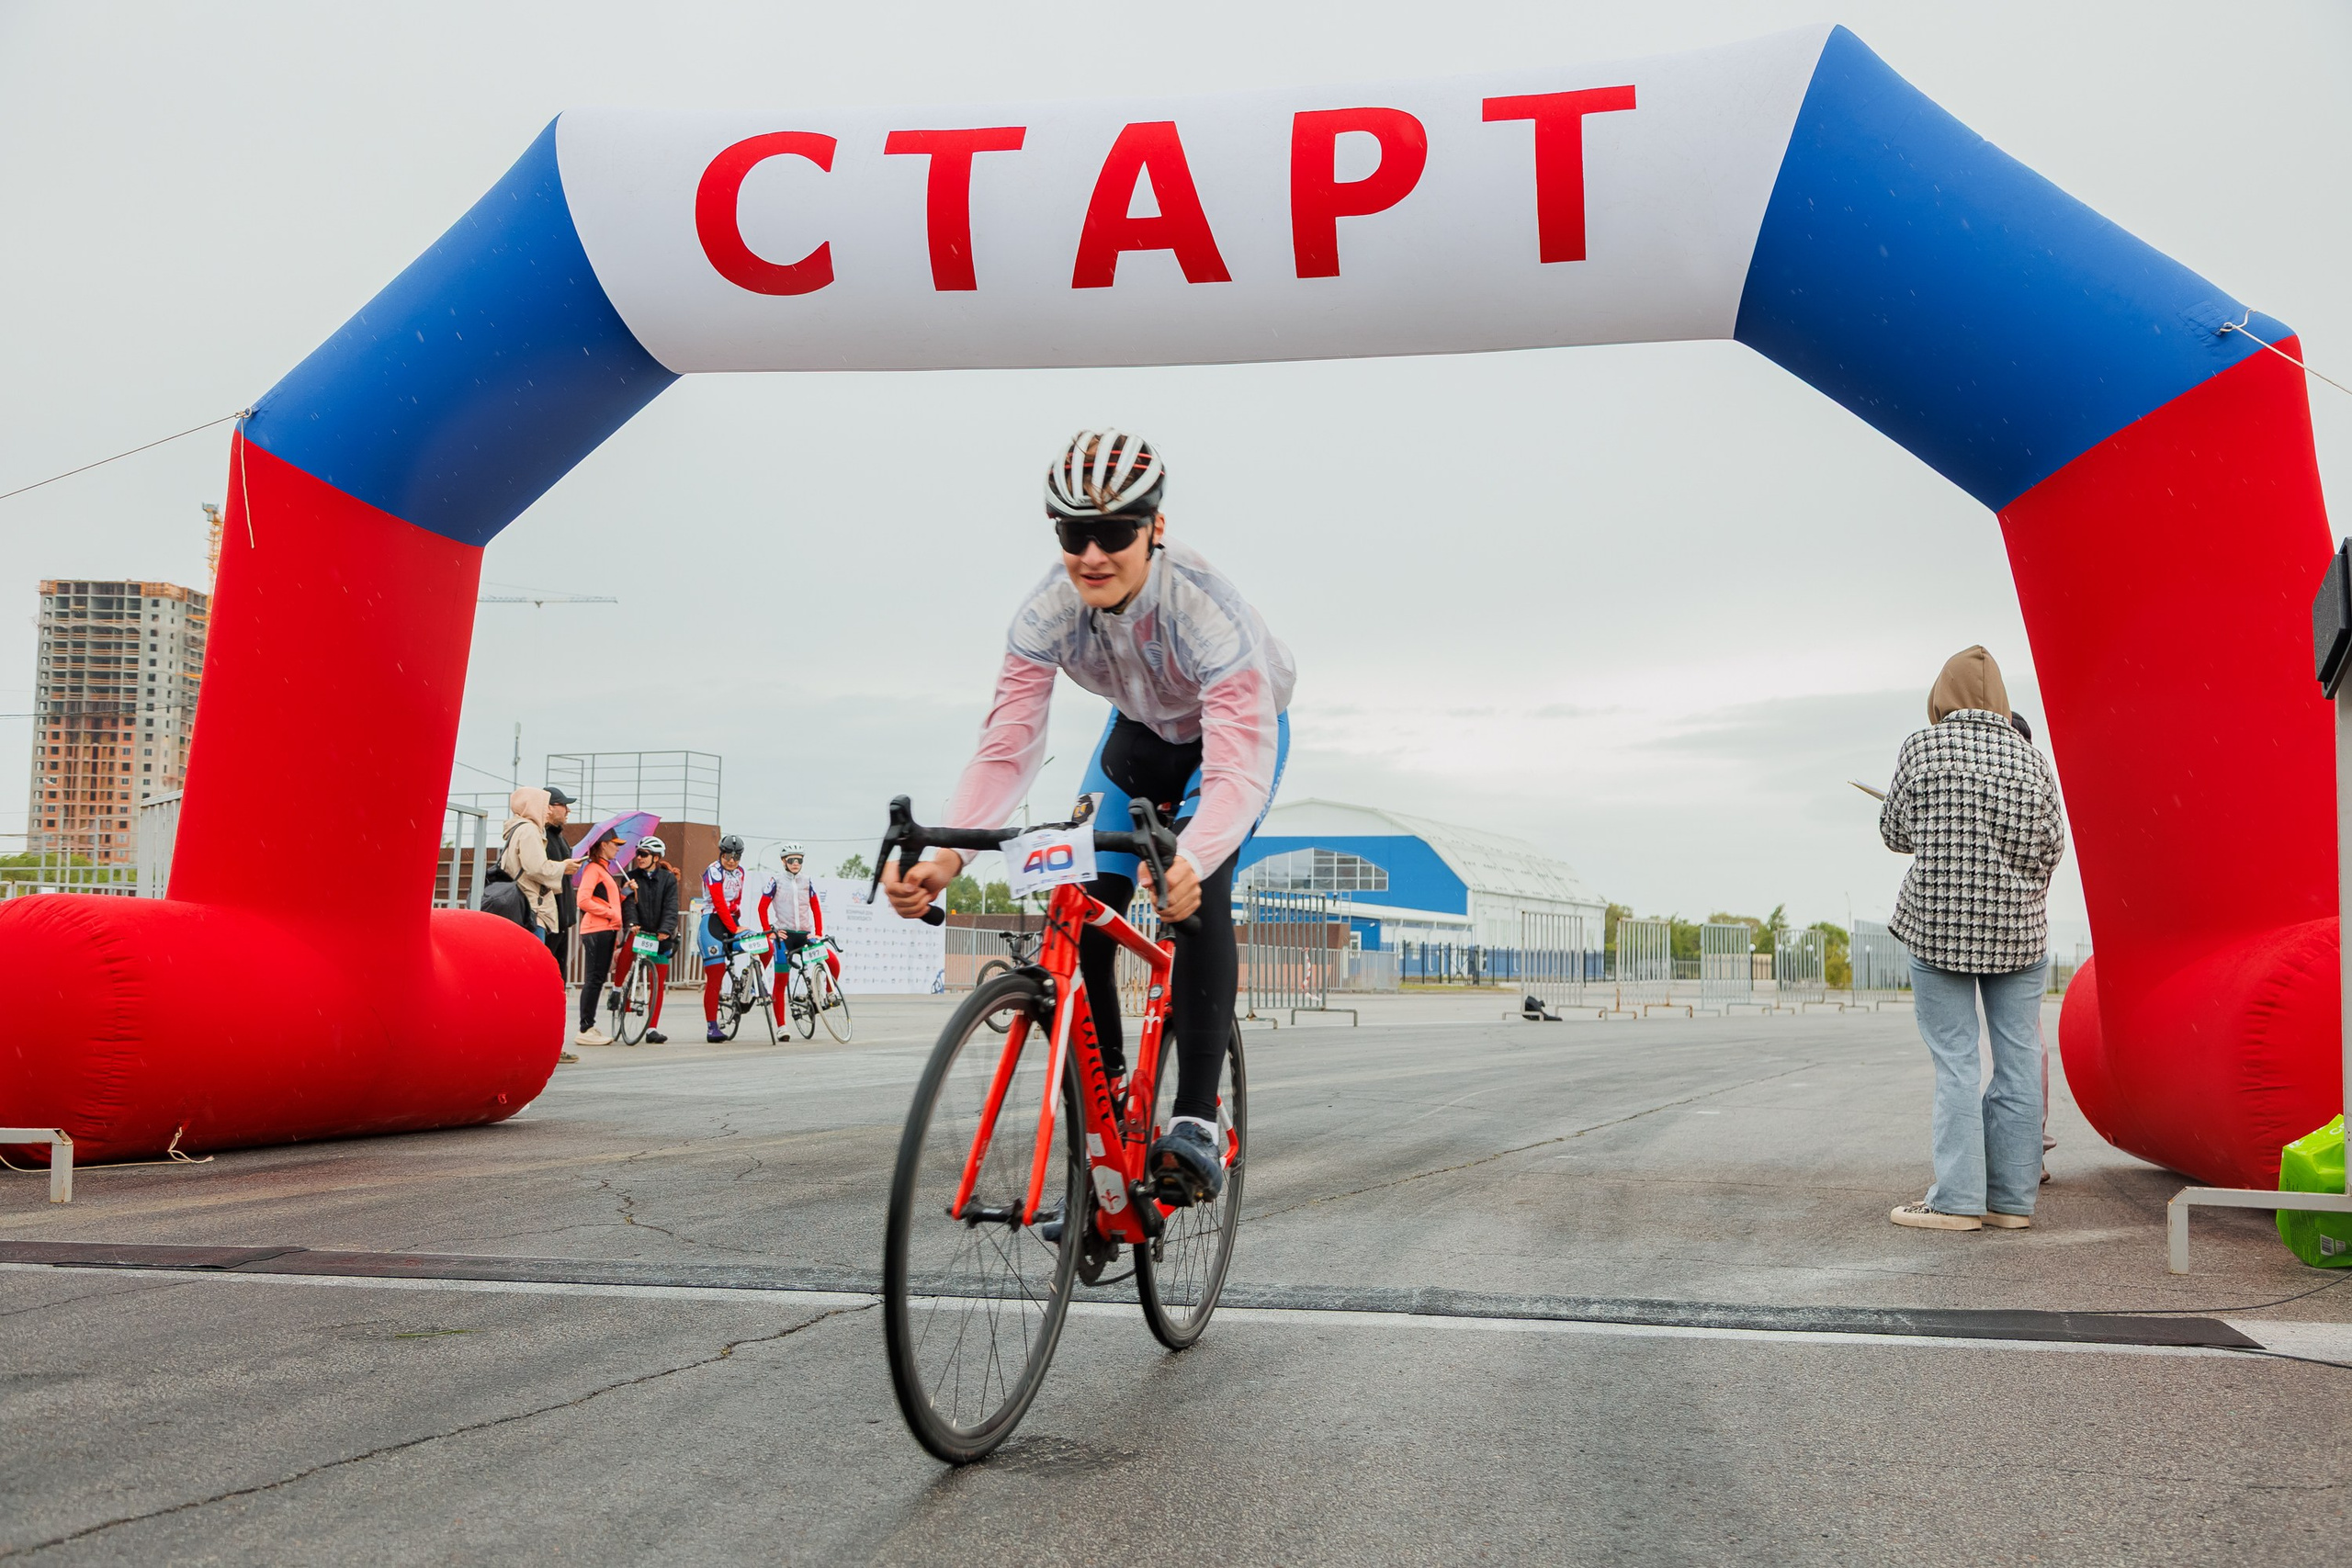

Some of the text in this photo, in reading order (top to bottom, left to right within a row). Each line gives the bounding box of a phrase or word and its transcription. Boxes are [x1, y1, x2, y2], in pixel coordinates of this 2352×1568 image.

[695, 85, 1635, 296] СТАРТ
[1023, 843, 1073, 874] 40
[640, 940, 654, 949] 859
[808, 949, 820, 959] 897
